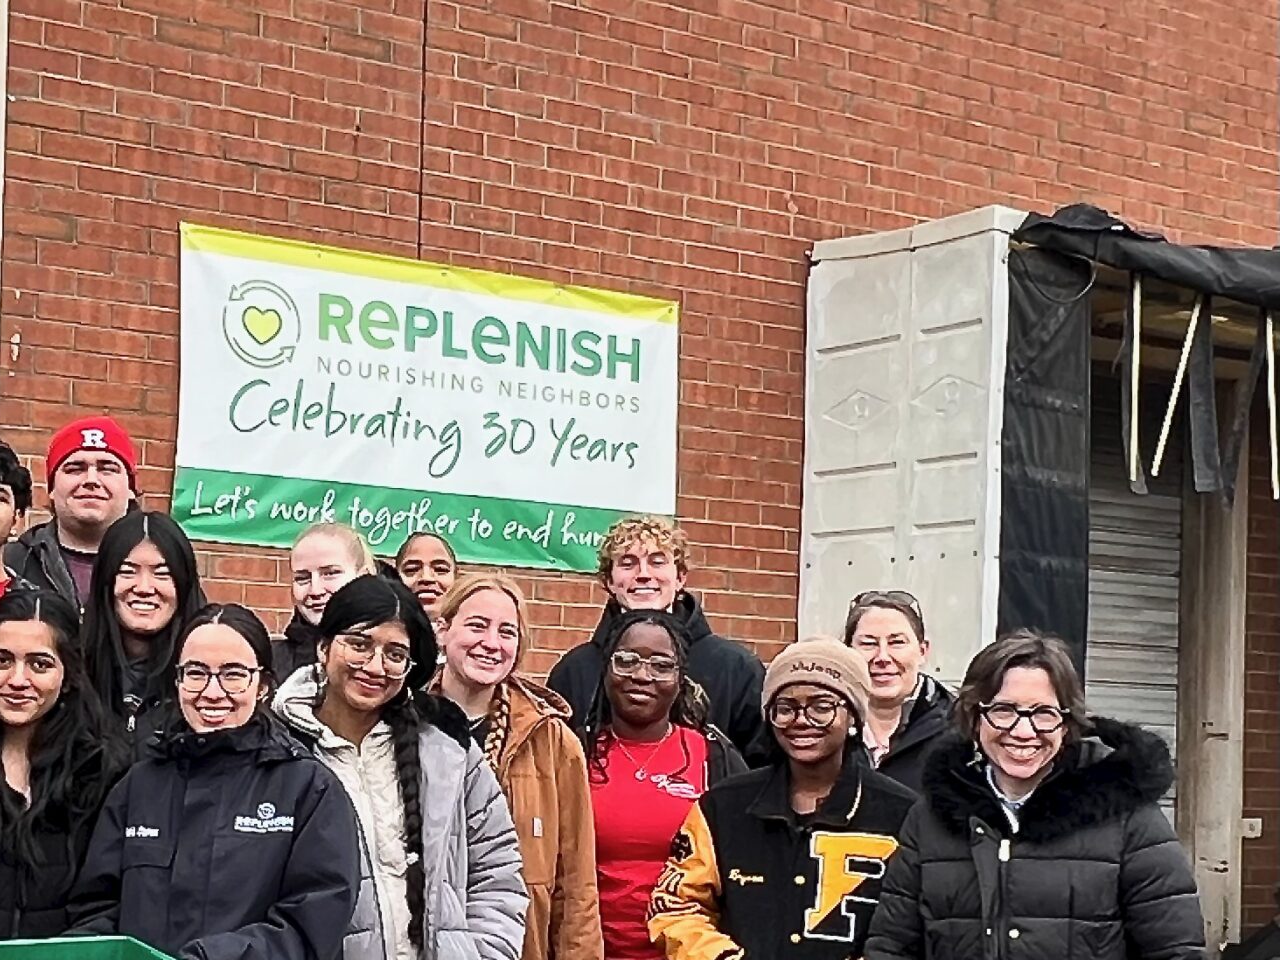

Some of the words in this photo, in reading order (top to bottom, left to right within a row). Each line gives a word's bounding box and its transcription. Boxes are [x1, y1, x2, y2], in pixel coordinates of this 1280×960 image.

[317, 356, 484, 394] NOURISHING
[498, 379, 641, 414] NEIGHBORS
[80, 428, 108, 449] R
[229, 378, 462, 479] Celebrating
[482, 411, 535, 459] 30
[549, 417, 639, 470] Years
[191, 480, 257, 520] Let's
[270, 489, 336, 523] work
[348, 497, 460, 545] together
[468, 508, 493, 541] to
[503, 509, 554, 548] end
[560, 511, 606, 547] hun
